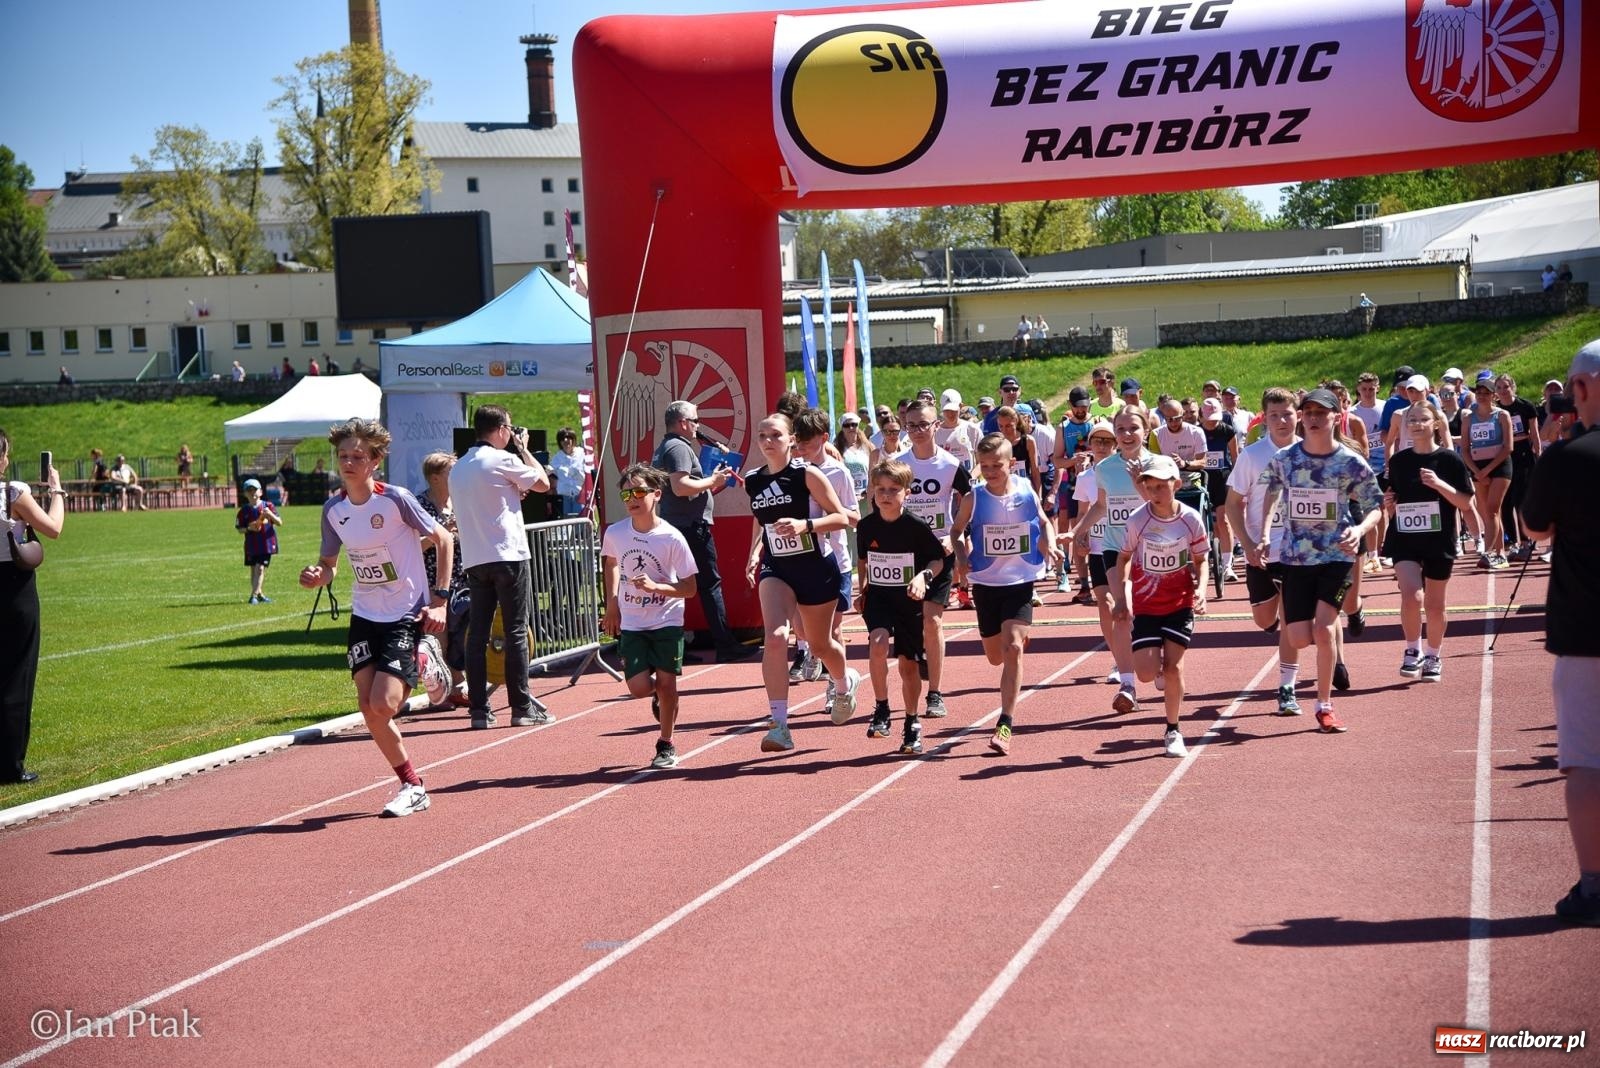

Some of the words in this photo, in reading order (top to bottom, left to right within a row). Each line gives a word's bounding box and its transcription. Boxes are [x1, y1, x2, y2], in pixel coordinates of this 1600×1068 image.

[1091, 0, 1233, 39] BIEG
[860, 39, 943, 73] SIR
[990, 62, 1108, 107] BEZ
[1118, 41, 1340, 98] GRANIC
[1021, 105, 1311, 163] RACIBÓRZ
[398, 362, 484, 377] PersonalBest
[1473, 431, 1488, 439] 049
[752, 493, 792, 510] adidas
[1112, 508, 1135, 521] 00
[1296, 502, 1322, 516] 015
[1404, 515, 1427, 528] 001
[774, 536, 798, 551] 016
[992, 537, 1016, 551] 012
[1150, 555, 1176, 568] 010
[356, 565, 383, 579] 005
[873, 566, 902, 580] 008
[624, 591, 666, 608] trophy
